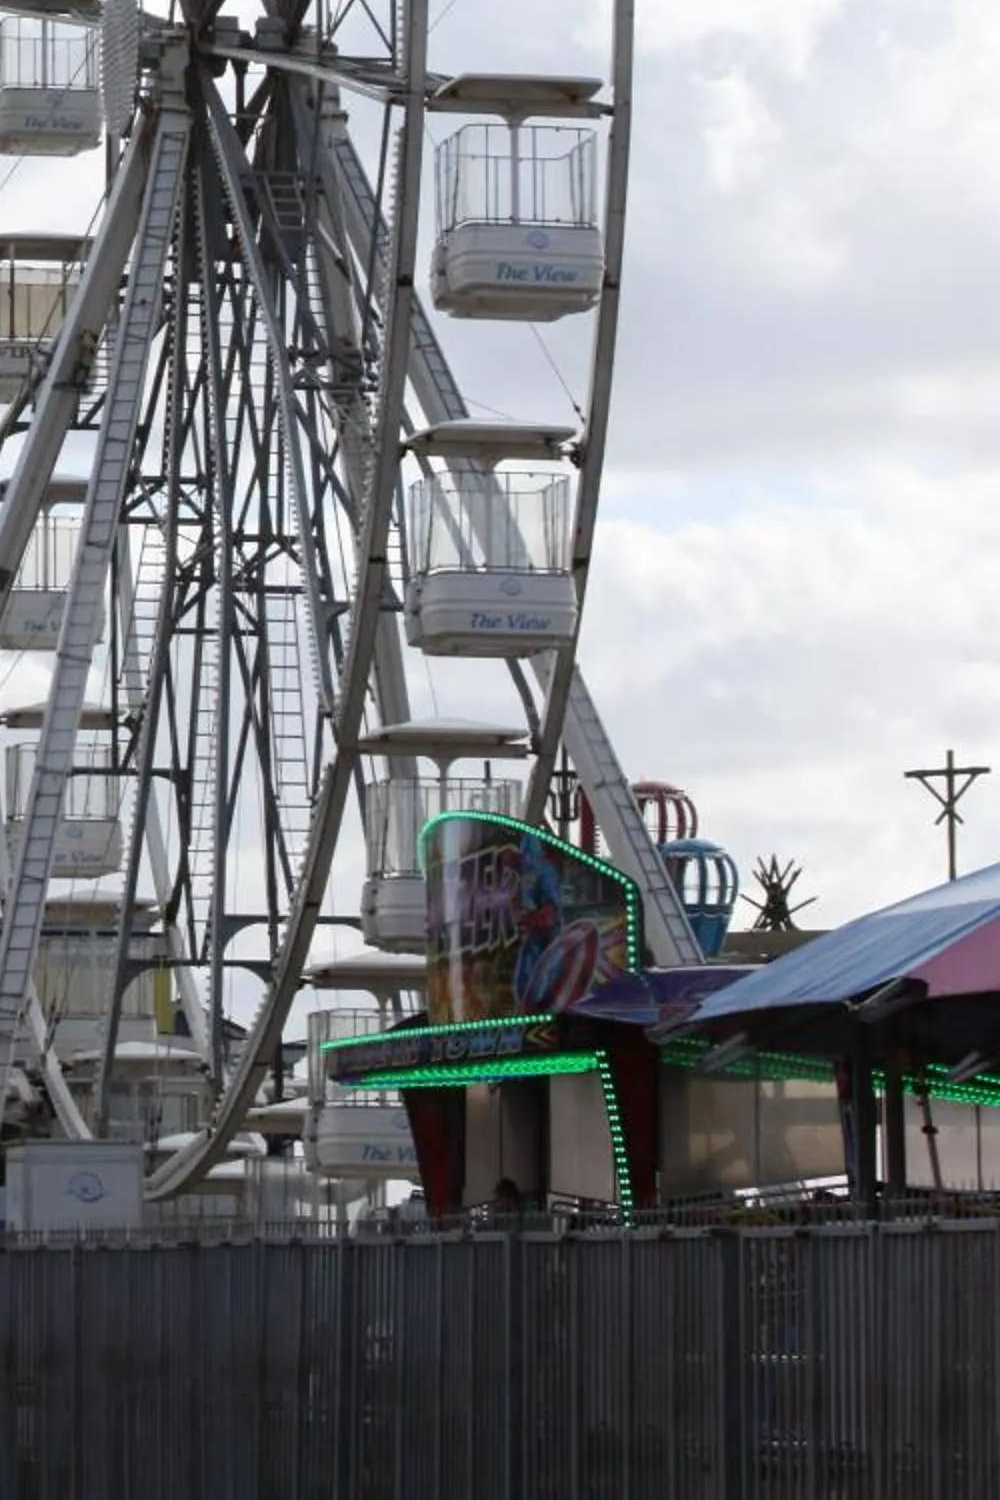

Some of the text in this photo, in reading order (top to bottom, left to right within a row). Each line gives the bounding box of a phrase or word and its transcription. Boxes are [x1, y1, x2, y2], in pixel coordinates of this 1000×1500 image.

[24, 116, 83, 130] The View
[495, 262, 578, 282] The View
[23, 619, 47, 632] The
[471, 612, 551, 629] The View
[71, 851, 103, 864] View
[360, 1143, 392, 1161] The
